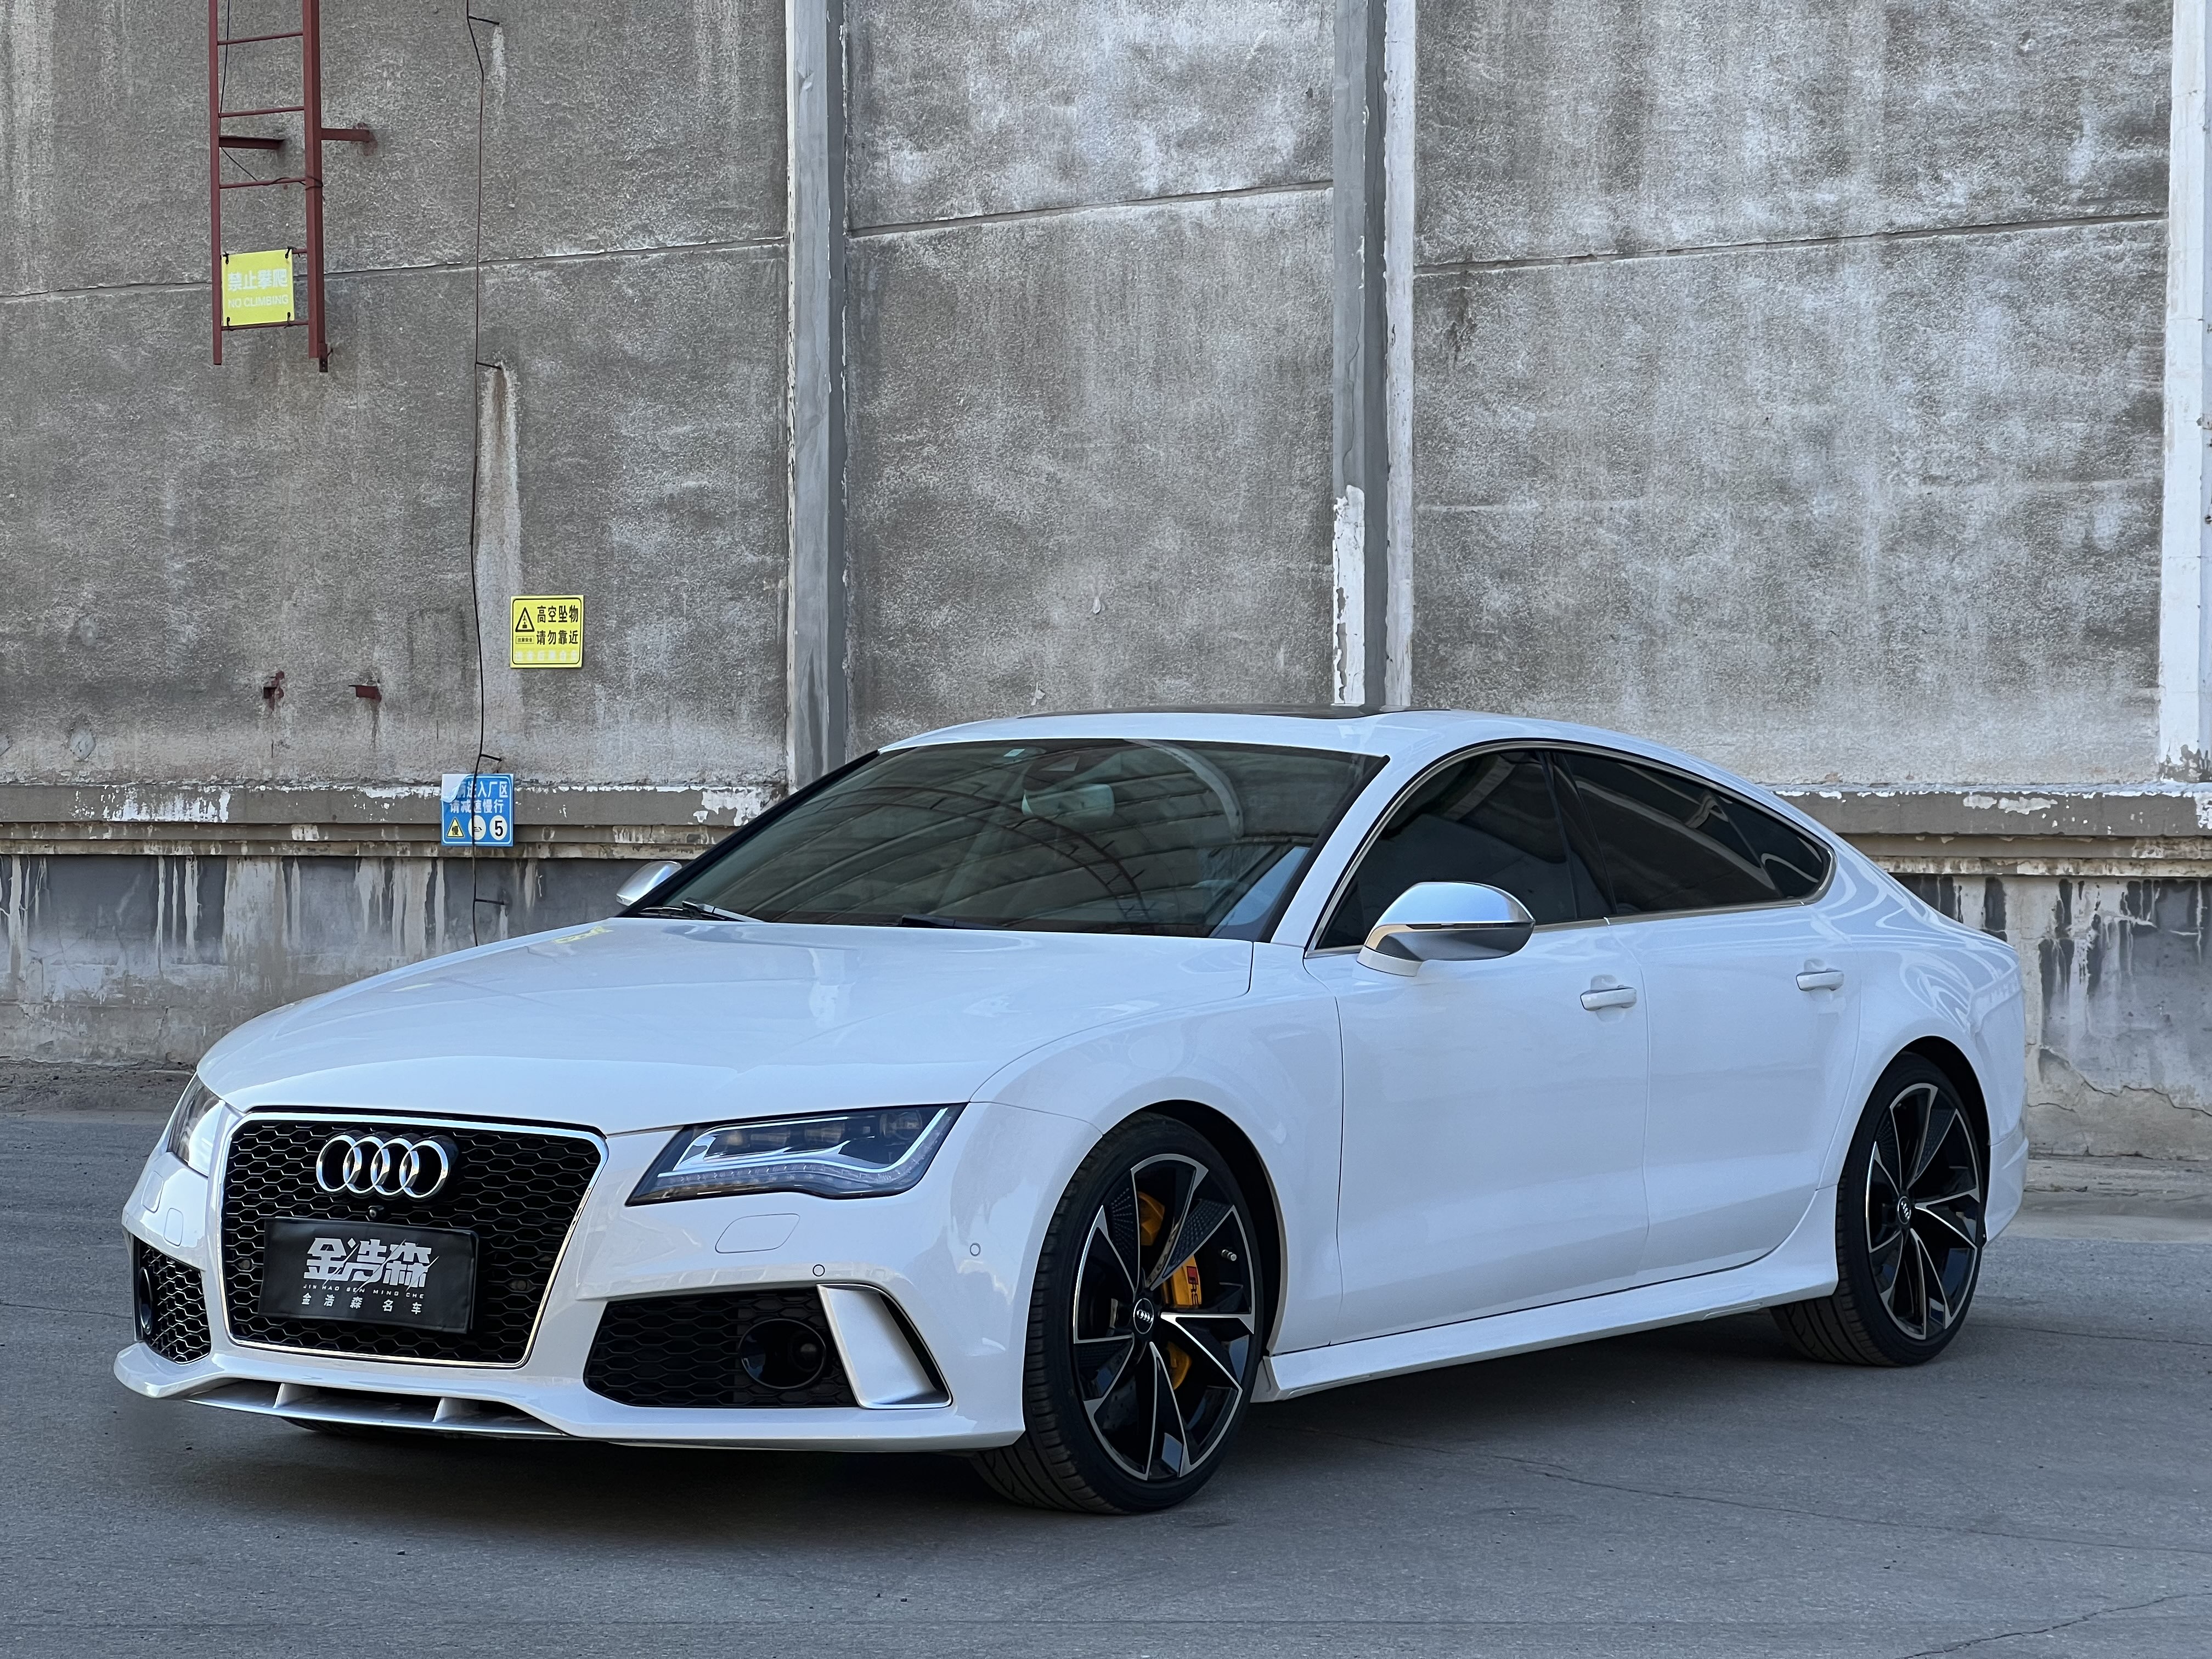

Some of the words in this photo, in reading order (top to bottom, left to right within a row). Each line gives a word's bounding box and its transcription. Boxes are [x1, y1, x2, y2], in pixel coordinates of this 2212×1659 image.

[228, 268, 288, 292] 禁止攀爬
[228, 298, 242, 308] NO
[244, 294, 289, 307] CLIMBING
[537, 605, 579, 623] 高空坠物
[537, 630, 578, 645] 请勿靠近
[450, 799, 504, 814] 请减速慢行
[495, 820, 503, 837] 5
[303, 1237, 433, 1289] 金浩森
[301, 1293, 422, 1315] 金浩森名车
